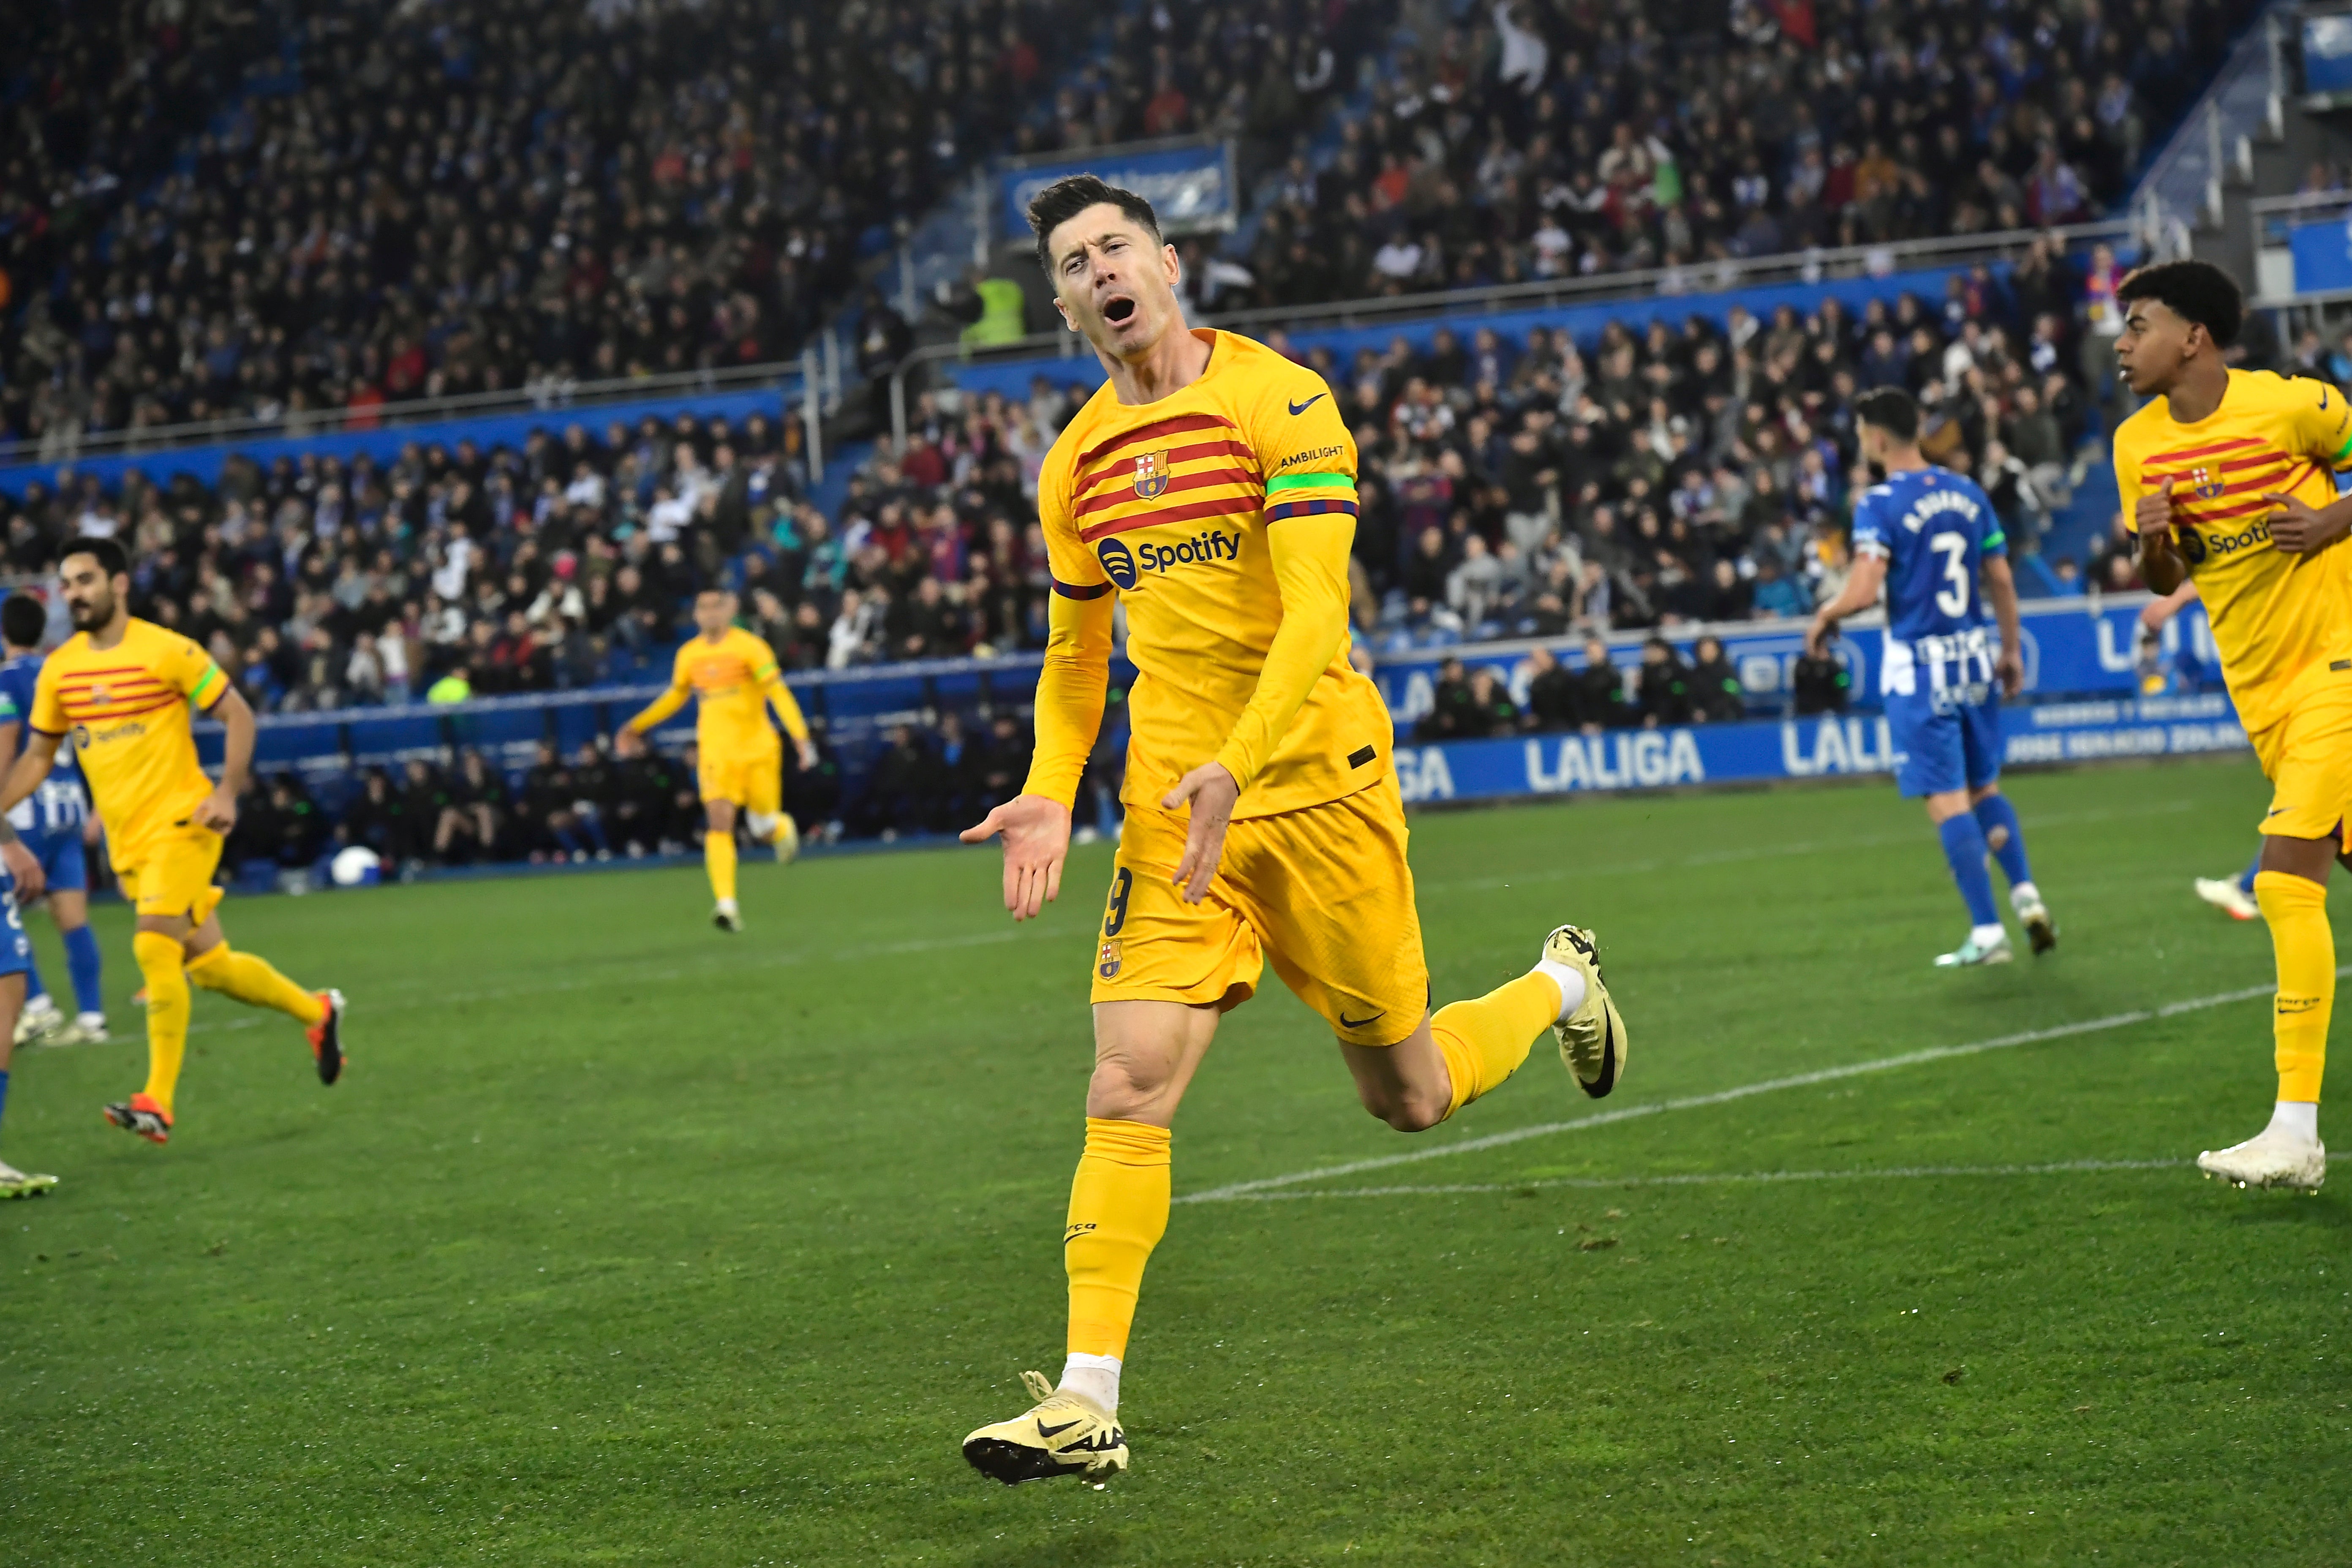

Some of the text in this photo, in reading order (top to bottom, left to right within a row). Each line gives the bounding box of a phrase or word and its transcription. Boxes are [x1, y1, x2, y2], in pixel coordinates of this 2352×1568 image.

[1145, 471, 1159, 479] FCB
[1281, 446, 1343, 468] AMBILIGHT
[1139, 531, 1240, 573] Spotify
[2209, 522, 2269, 554] Spoti
[1931, 531, 1969, 618] 3
[1525, 728, 1705, 793] LALIGA
[1783, 715, 1893, 776] LALI
[1394, 746, 1455, 801] GA
[1105, 866, 1132, 937] 9
[1067, 1223, 1097, 1232] rça
